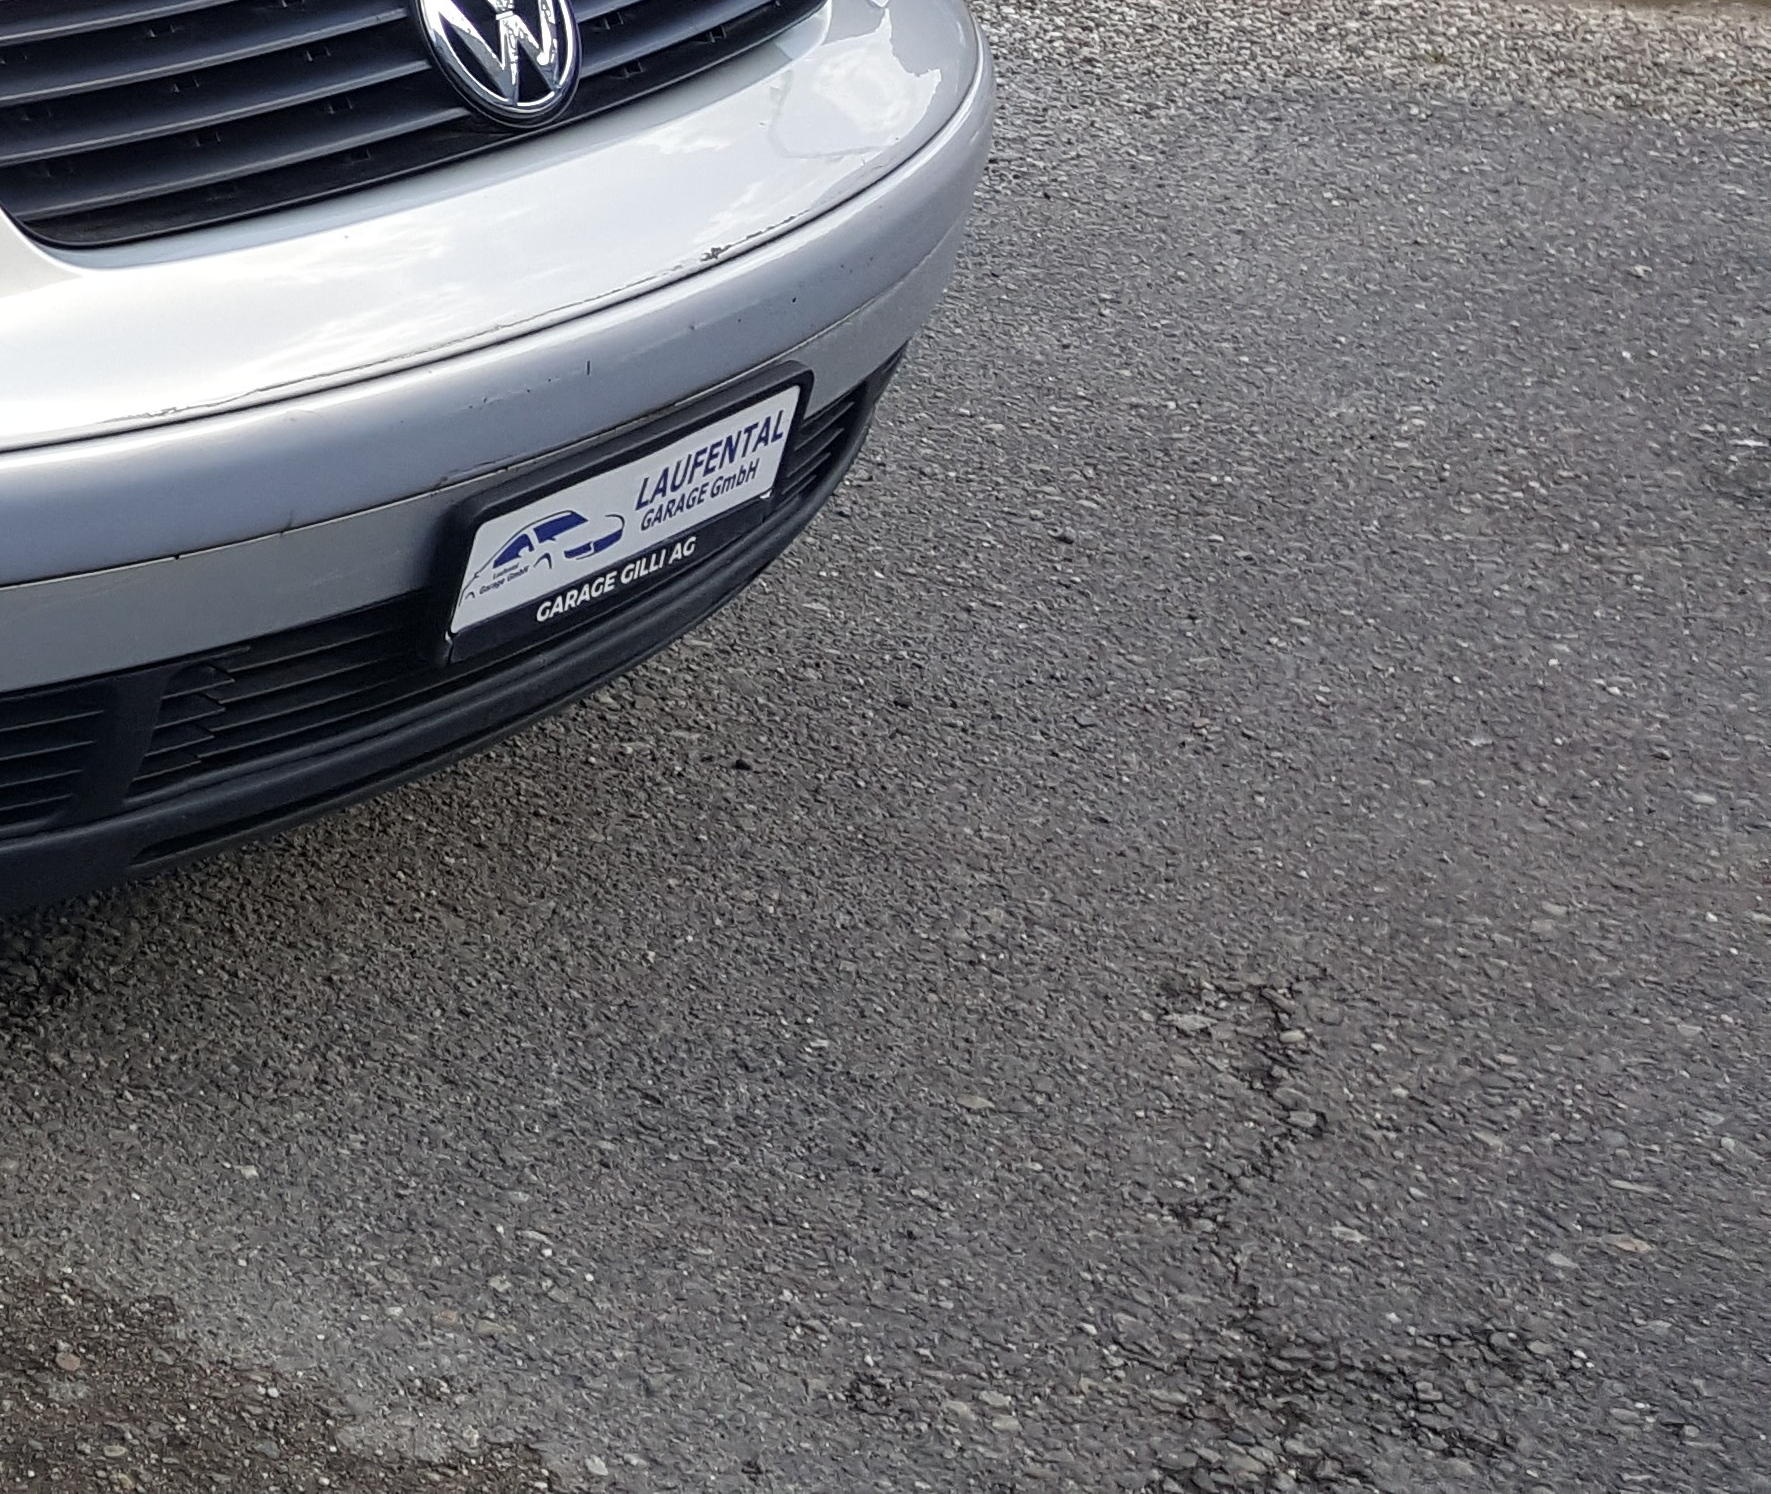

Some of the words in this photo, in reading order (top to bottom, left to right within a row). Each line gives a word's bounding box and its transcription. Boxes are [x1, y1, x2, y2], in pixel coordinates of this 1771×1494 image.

[635, 409, 784, 511] LAUFENTAL
[640, 481, 709, 531] GARAGE
[711, 457, 761, 499] GmbH
[536, 570, 618, 623] GARAGE
[620, 547, 667, 586] GILLI
[668, 536, 698, 563] AG
